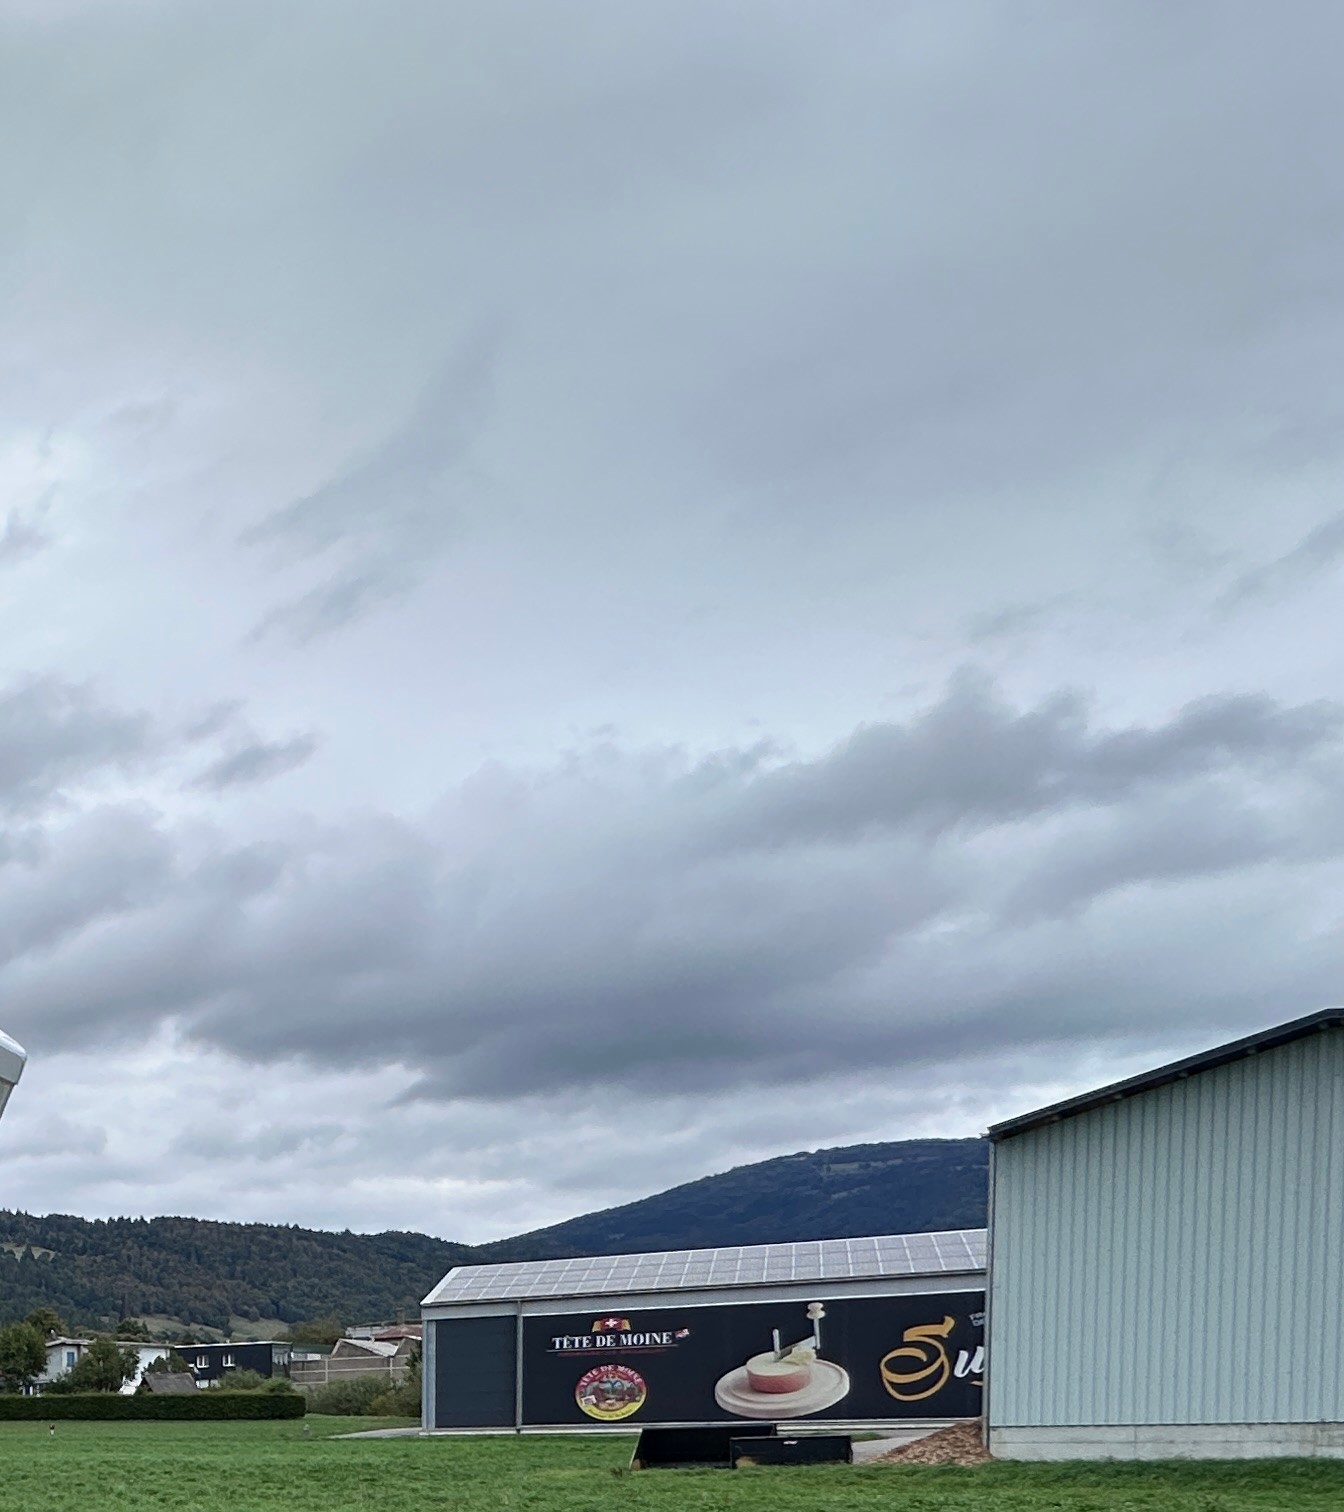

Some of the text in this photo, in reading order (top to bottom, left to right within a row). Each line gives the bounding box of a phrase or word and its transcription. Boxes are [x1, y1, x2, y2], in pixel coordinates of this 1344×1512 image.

[552, 1334, 592, 1350] TÊTE
[595, 1334, 616, 1348] DE
[620, 1331, 672, 1347] MOINE
